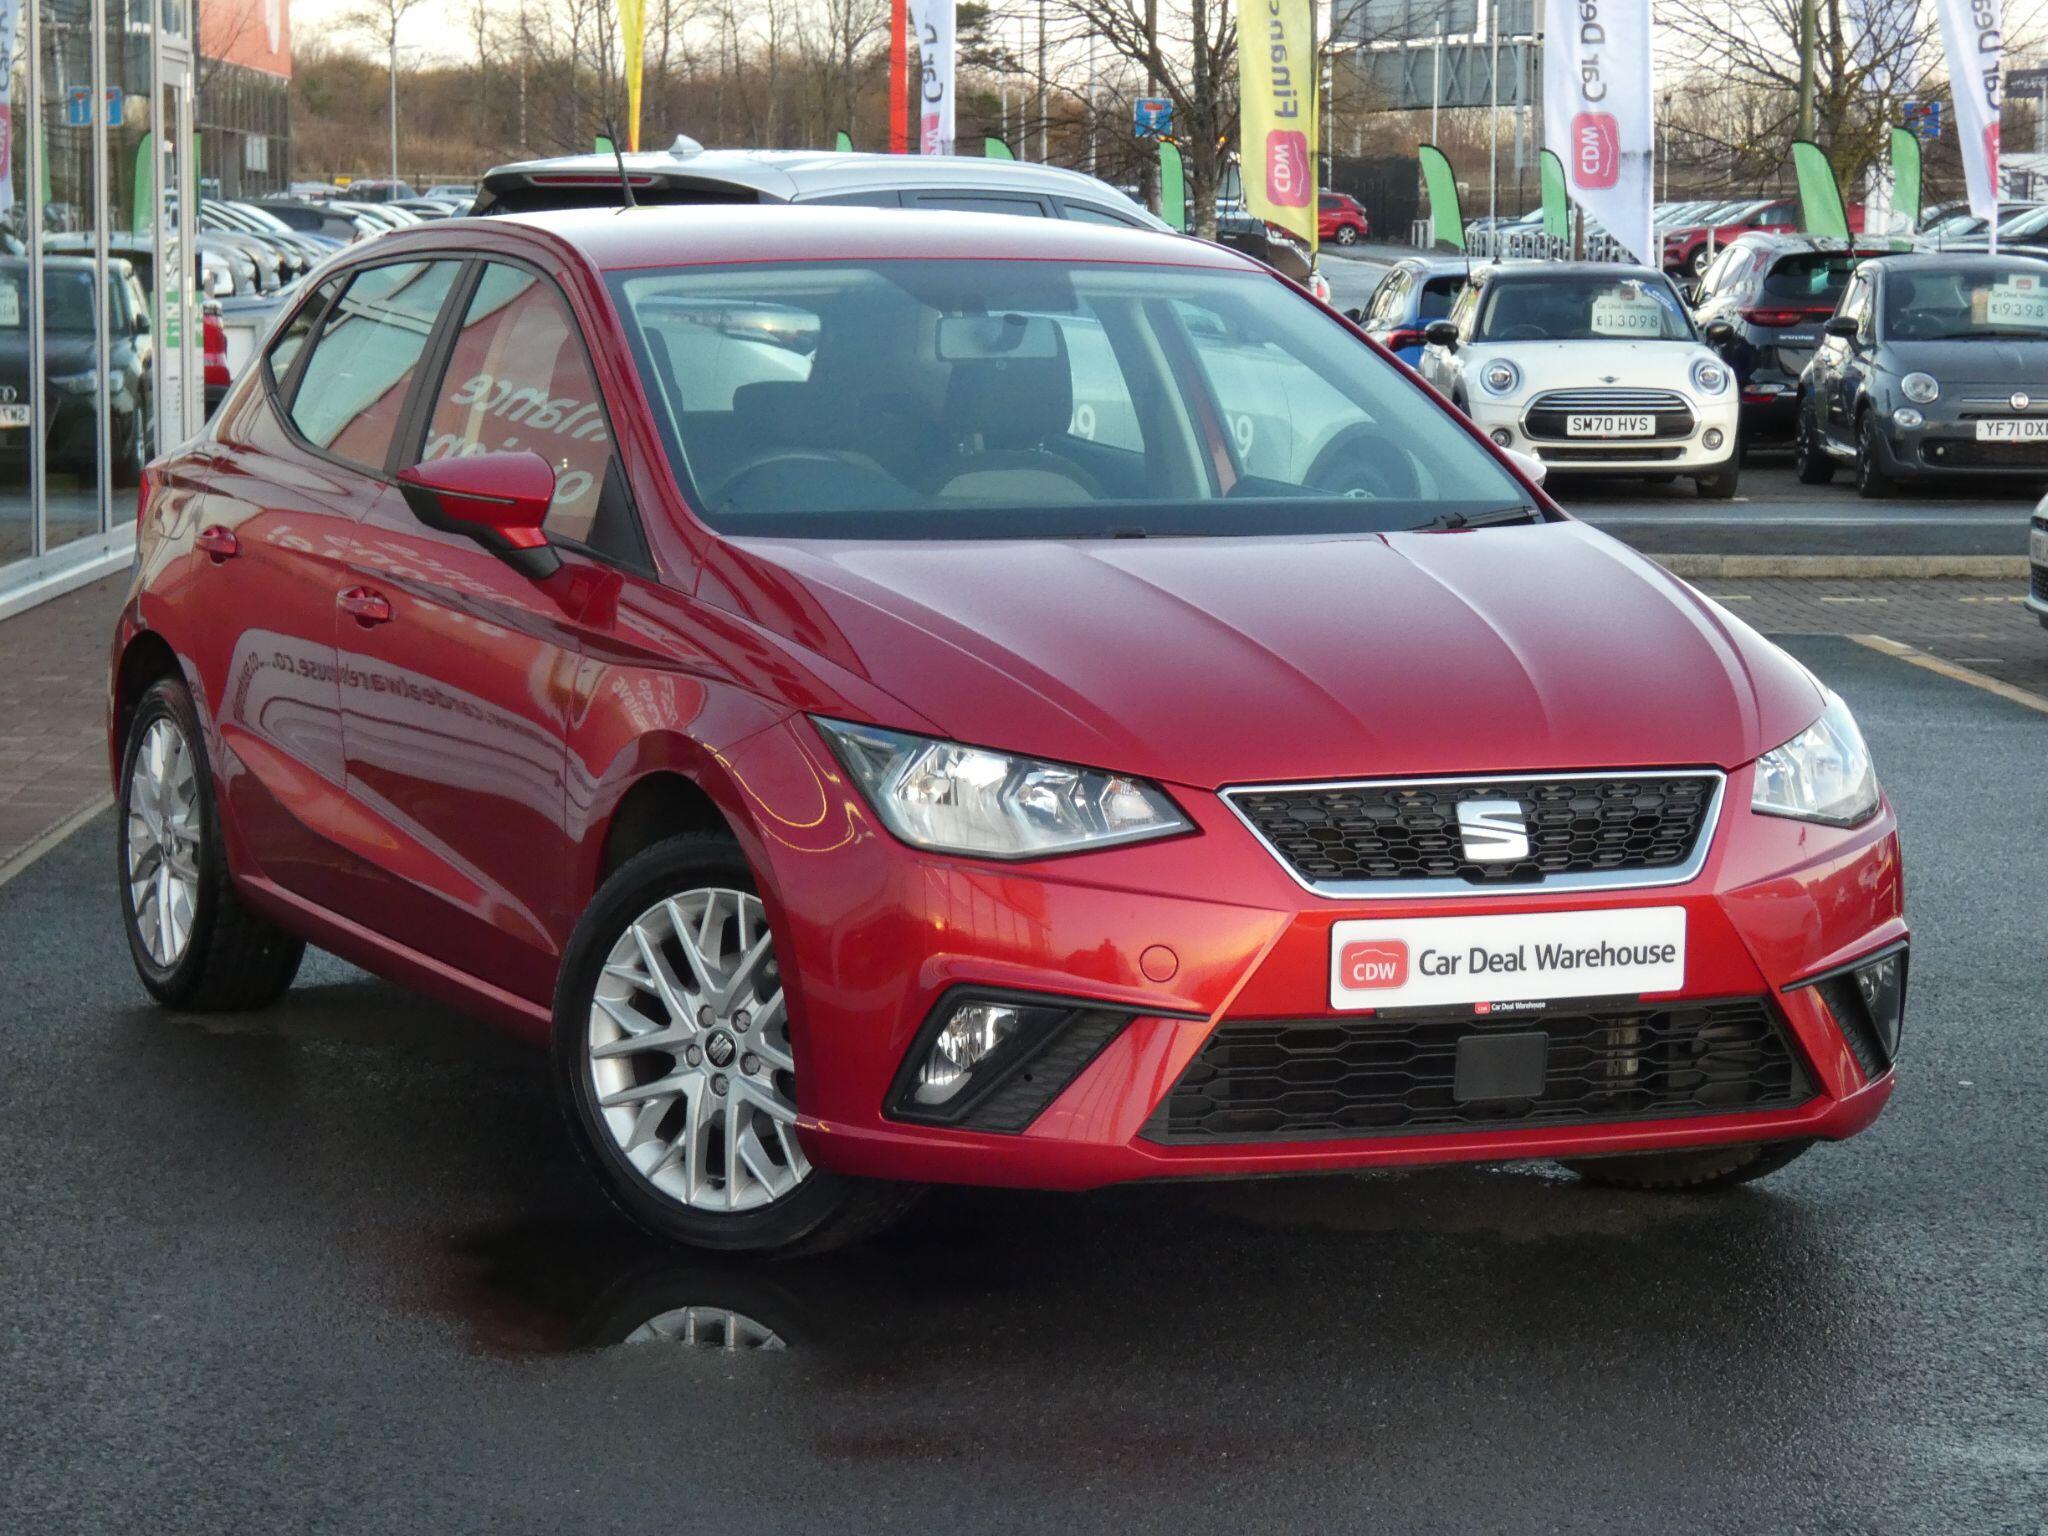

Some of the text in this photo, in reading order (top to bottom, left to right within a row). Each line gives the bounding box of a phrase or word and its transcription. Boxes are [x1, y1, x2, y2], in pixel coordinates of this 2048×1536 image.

[1573, 417, 1648, 431] SM70 HVS
[1986, 422, 2020, 436] YF71
[1418, 940, 1676, 976] Car Deal Warehouse
[1353, 962, 1396, 982] CDW
